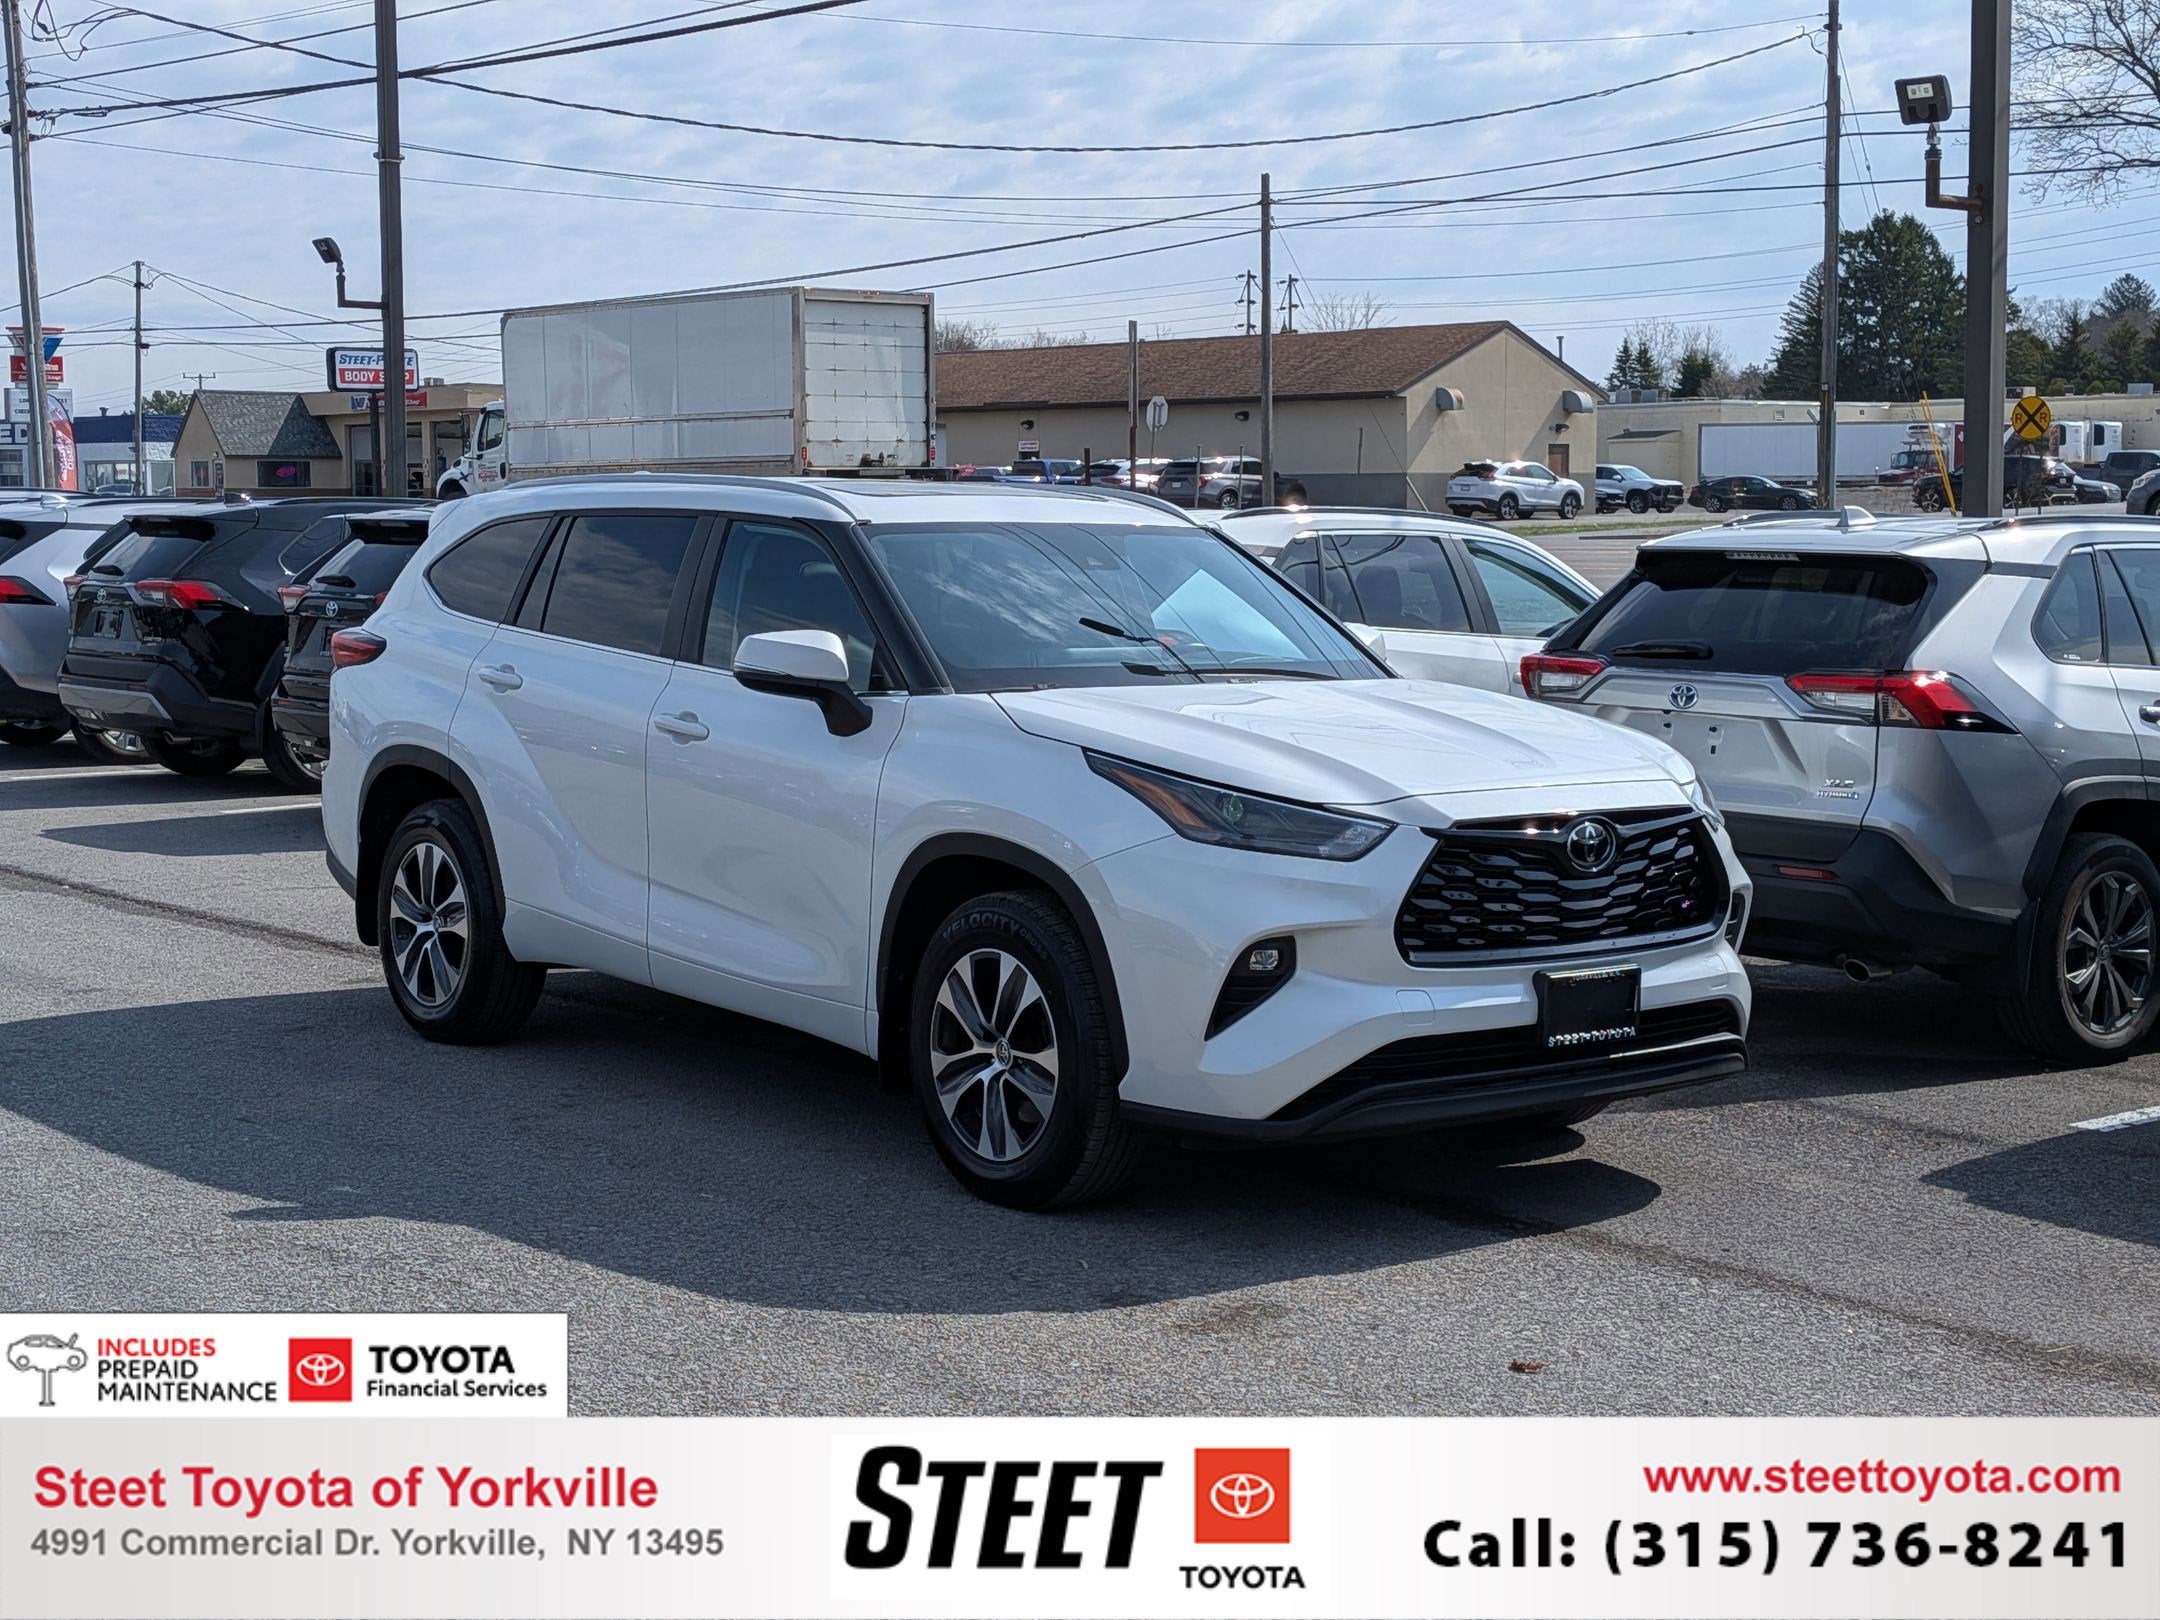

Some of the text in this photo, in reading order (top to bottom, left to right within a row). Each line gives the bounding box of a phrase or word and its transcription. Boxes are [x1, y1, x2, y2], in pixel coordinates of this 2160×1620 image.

[345, 371, 410, 382] BODY SP
[2015, 412, 2047, 423] R R
[942, 912, 1020, 938] VELOCITY
